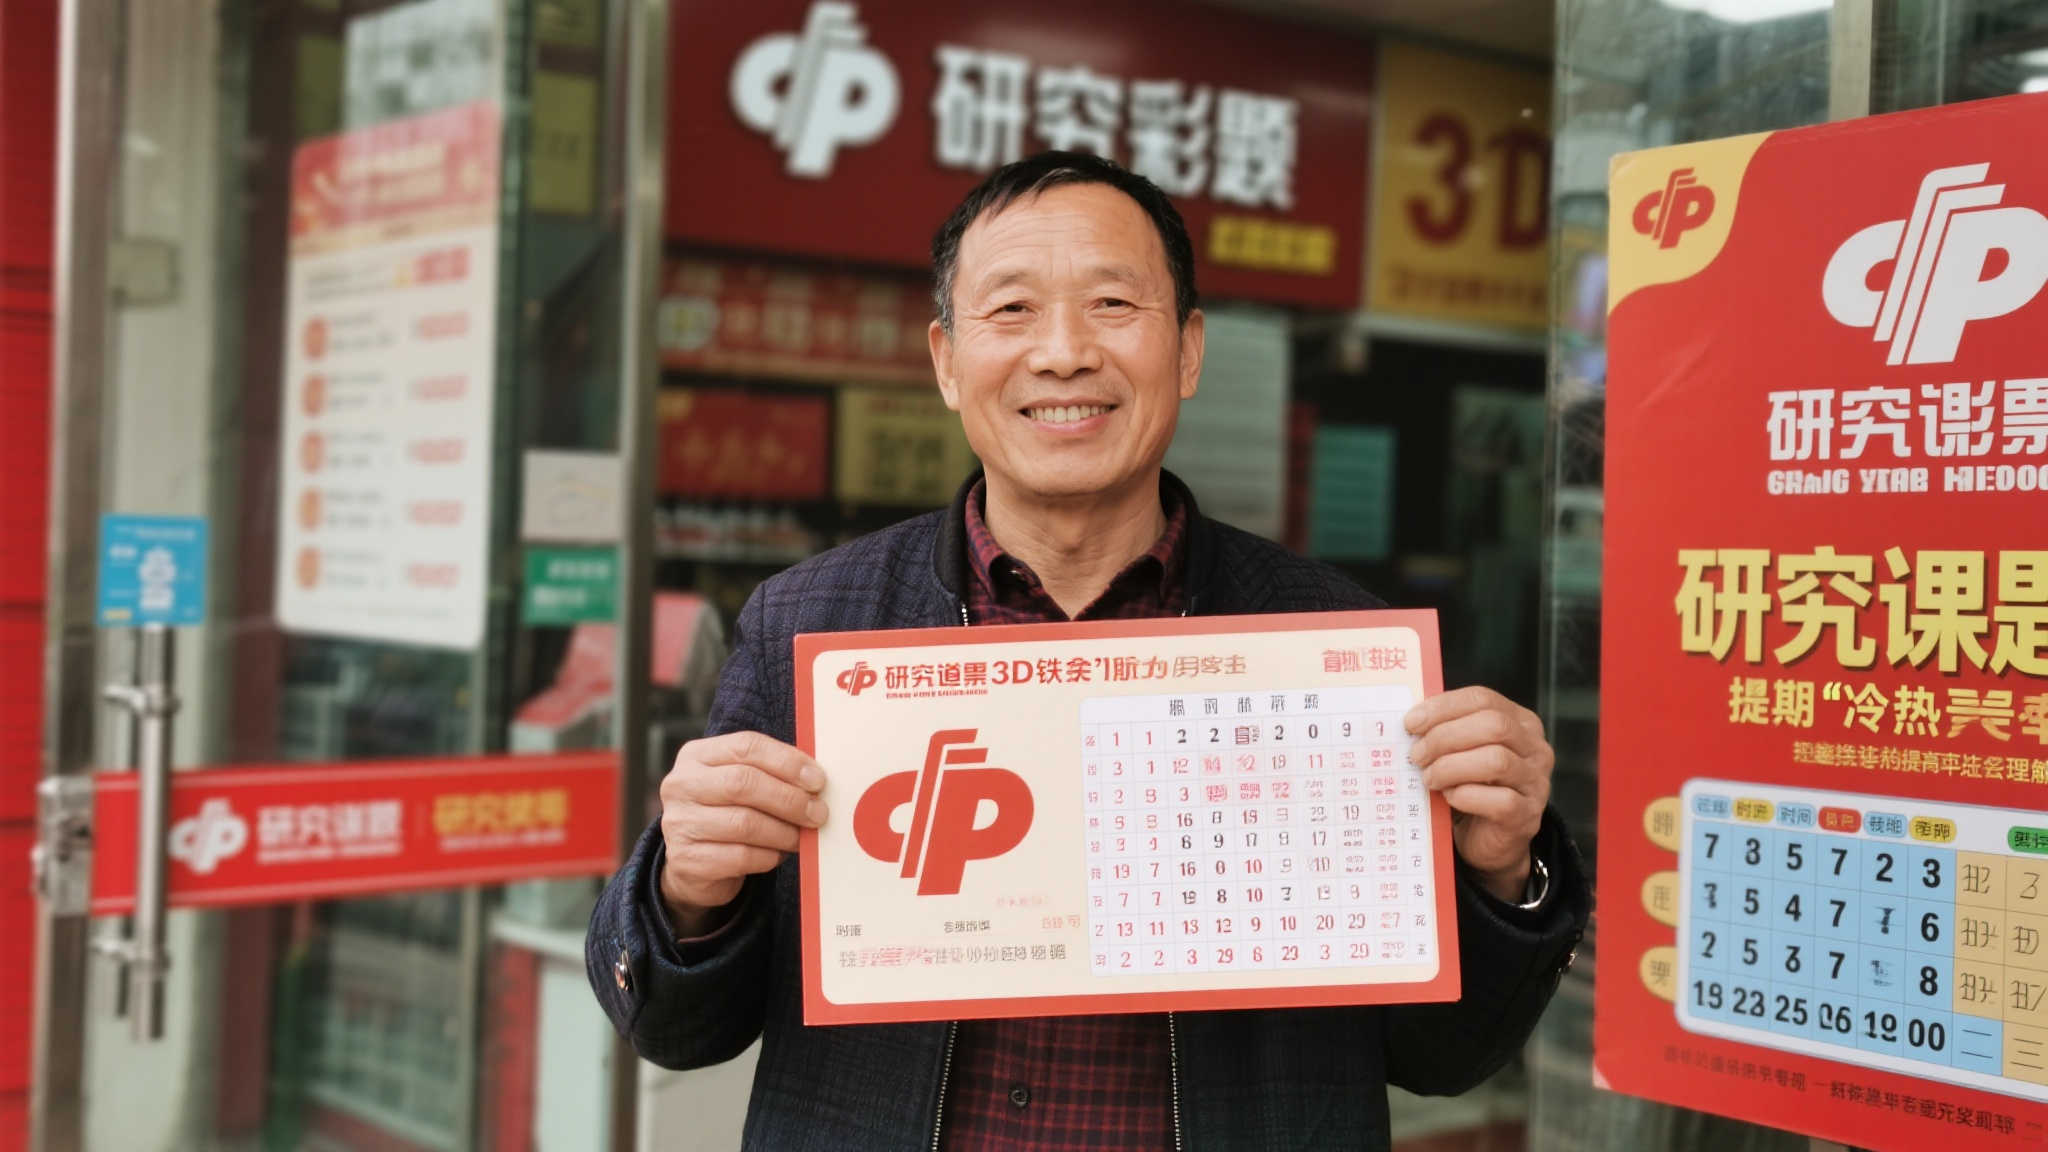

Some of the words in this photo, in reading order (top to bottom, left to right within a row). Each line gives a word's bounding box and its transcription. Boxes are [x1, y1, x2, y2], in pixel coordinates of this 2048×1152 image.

[1178, 729, 1187, 743] 2
[1209, 728, 1220, 742] 2
[1274, 725, 1284, 740] 2
[1309, 724, 1318, 738] 0
[1113, 761, 1122, 775] 3
[1308, 754, 1323, 768] 11
[1179, 787, 1188, 801] 3
[1177, 812, 1193, 827] 16
[1150, 862, 1159, 877] 7
[1180, 861, 1196, 876] 16
[1245, 858, 1262, 874] 10
[1704, 833, 1719, 858] 7
[1745, 839, 1761, 865] 3
[1787, 844, 1803, 870] 5
[1831, 848, 1848, 876] 7
[1875, 853, 1893, 882] 2
[1922, 859, 1941, 888] 3
[1118, 893, 1128, 907] 7
[1152, 892, 1161, 906] 7
[1216, 889, 1227, 904] 8
[1246, 888, 1263, 902] 10
[1116, 922, 1133, 937] 13
[1150, 921, 1164, 936] 11
[1183, 920, 1199, 934] 13
[1250, 916, 1261, 932] 9
[1280, 916, 1296, 931] 10
[1316, 914, 1334, 930] 20
[1744, 889, 1760, 914] 5
[1785, 895, 1802, 921] 4
[1830, 900, 1846, 927] 7
[1920, 912, 1939, 942] 6
[1120, 952, 1131, 968] 2
[1154, 950, 1164, 966] 2
[1187, 948, 1198, 964] 3
[1253, 946, 1263, 962] 6
[1320, 944, 1330, 960] 3
[1701, 931, 1716, 958] 2
[1743, 939, 1759, 965] 5
[1785, 946, 1801, 973] 3
[1829, 951, 1845, 979] 7
[1919, 966, 1938, 996] 8
[1775, 995, 1807, 1026] 25
[1909, 1019, 1945, 1051] 00
